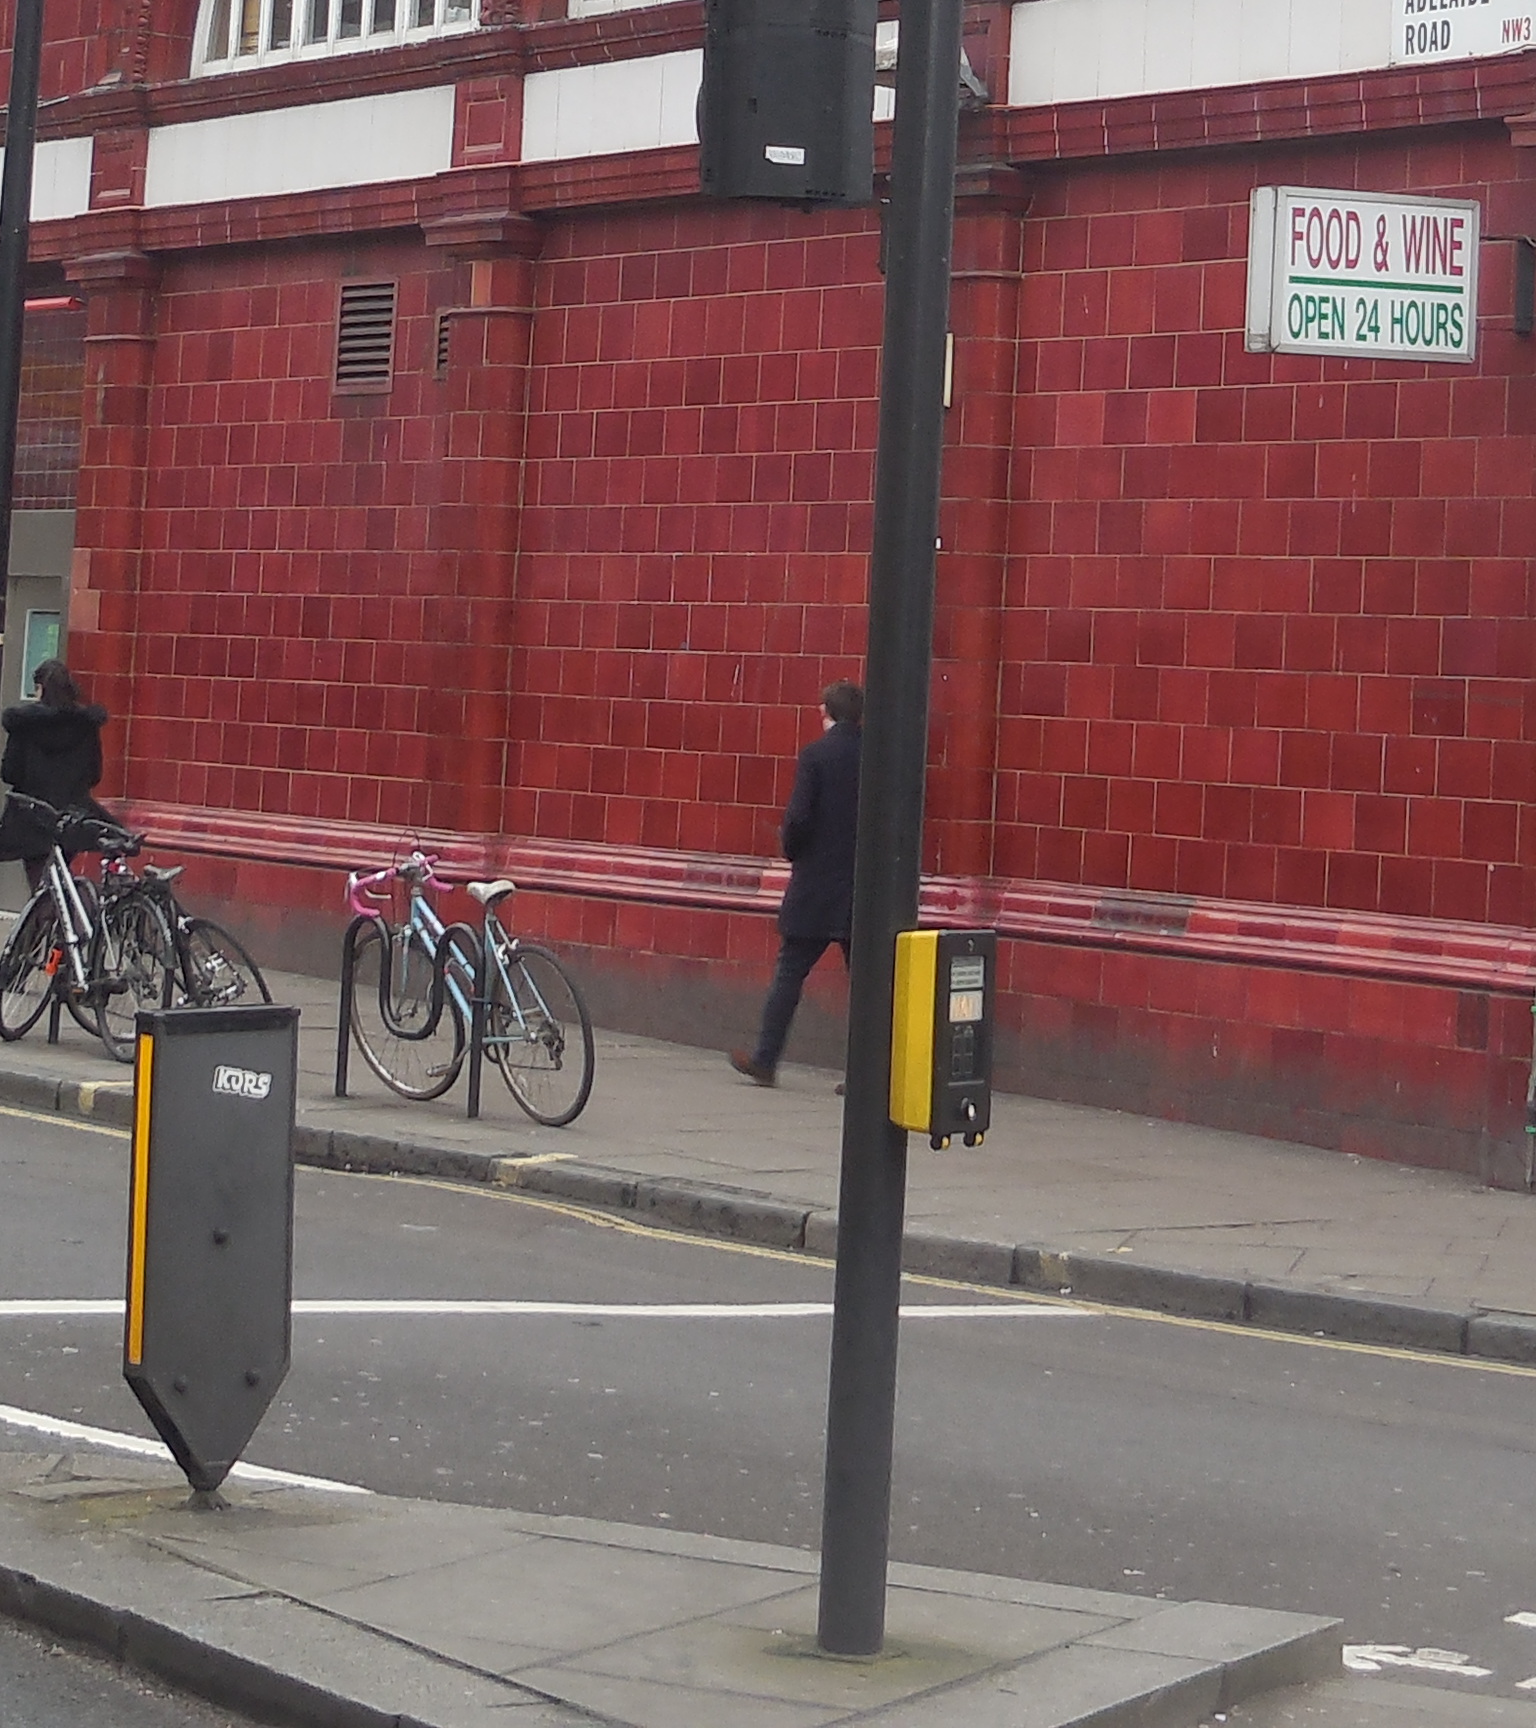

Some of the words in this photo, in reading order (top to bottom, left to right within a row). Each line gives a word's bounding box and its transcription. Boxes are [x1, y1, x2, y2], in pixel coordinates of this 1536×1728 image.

[1405, 20, 1451, 55] ROAD
[1502, 17, 1532, 43] NW3
[1290, 205, 1362, 270] FOOD
[1373, 214, 1390, 273] &
[1402, 213, 1464, 277] WINE
[1288, 293, 1345, 341] OPEN
[1354, 297, 1381, 343] 24
[1390, 299, 1464, 349] HOURS
